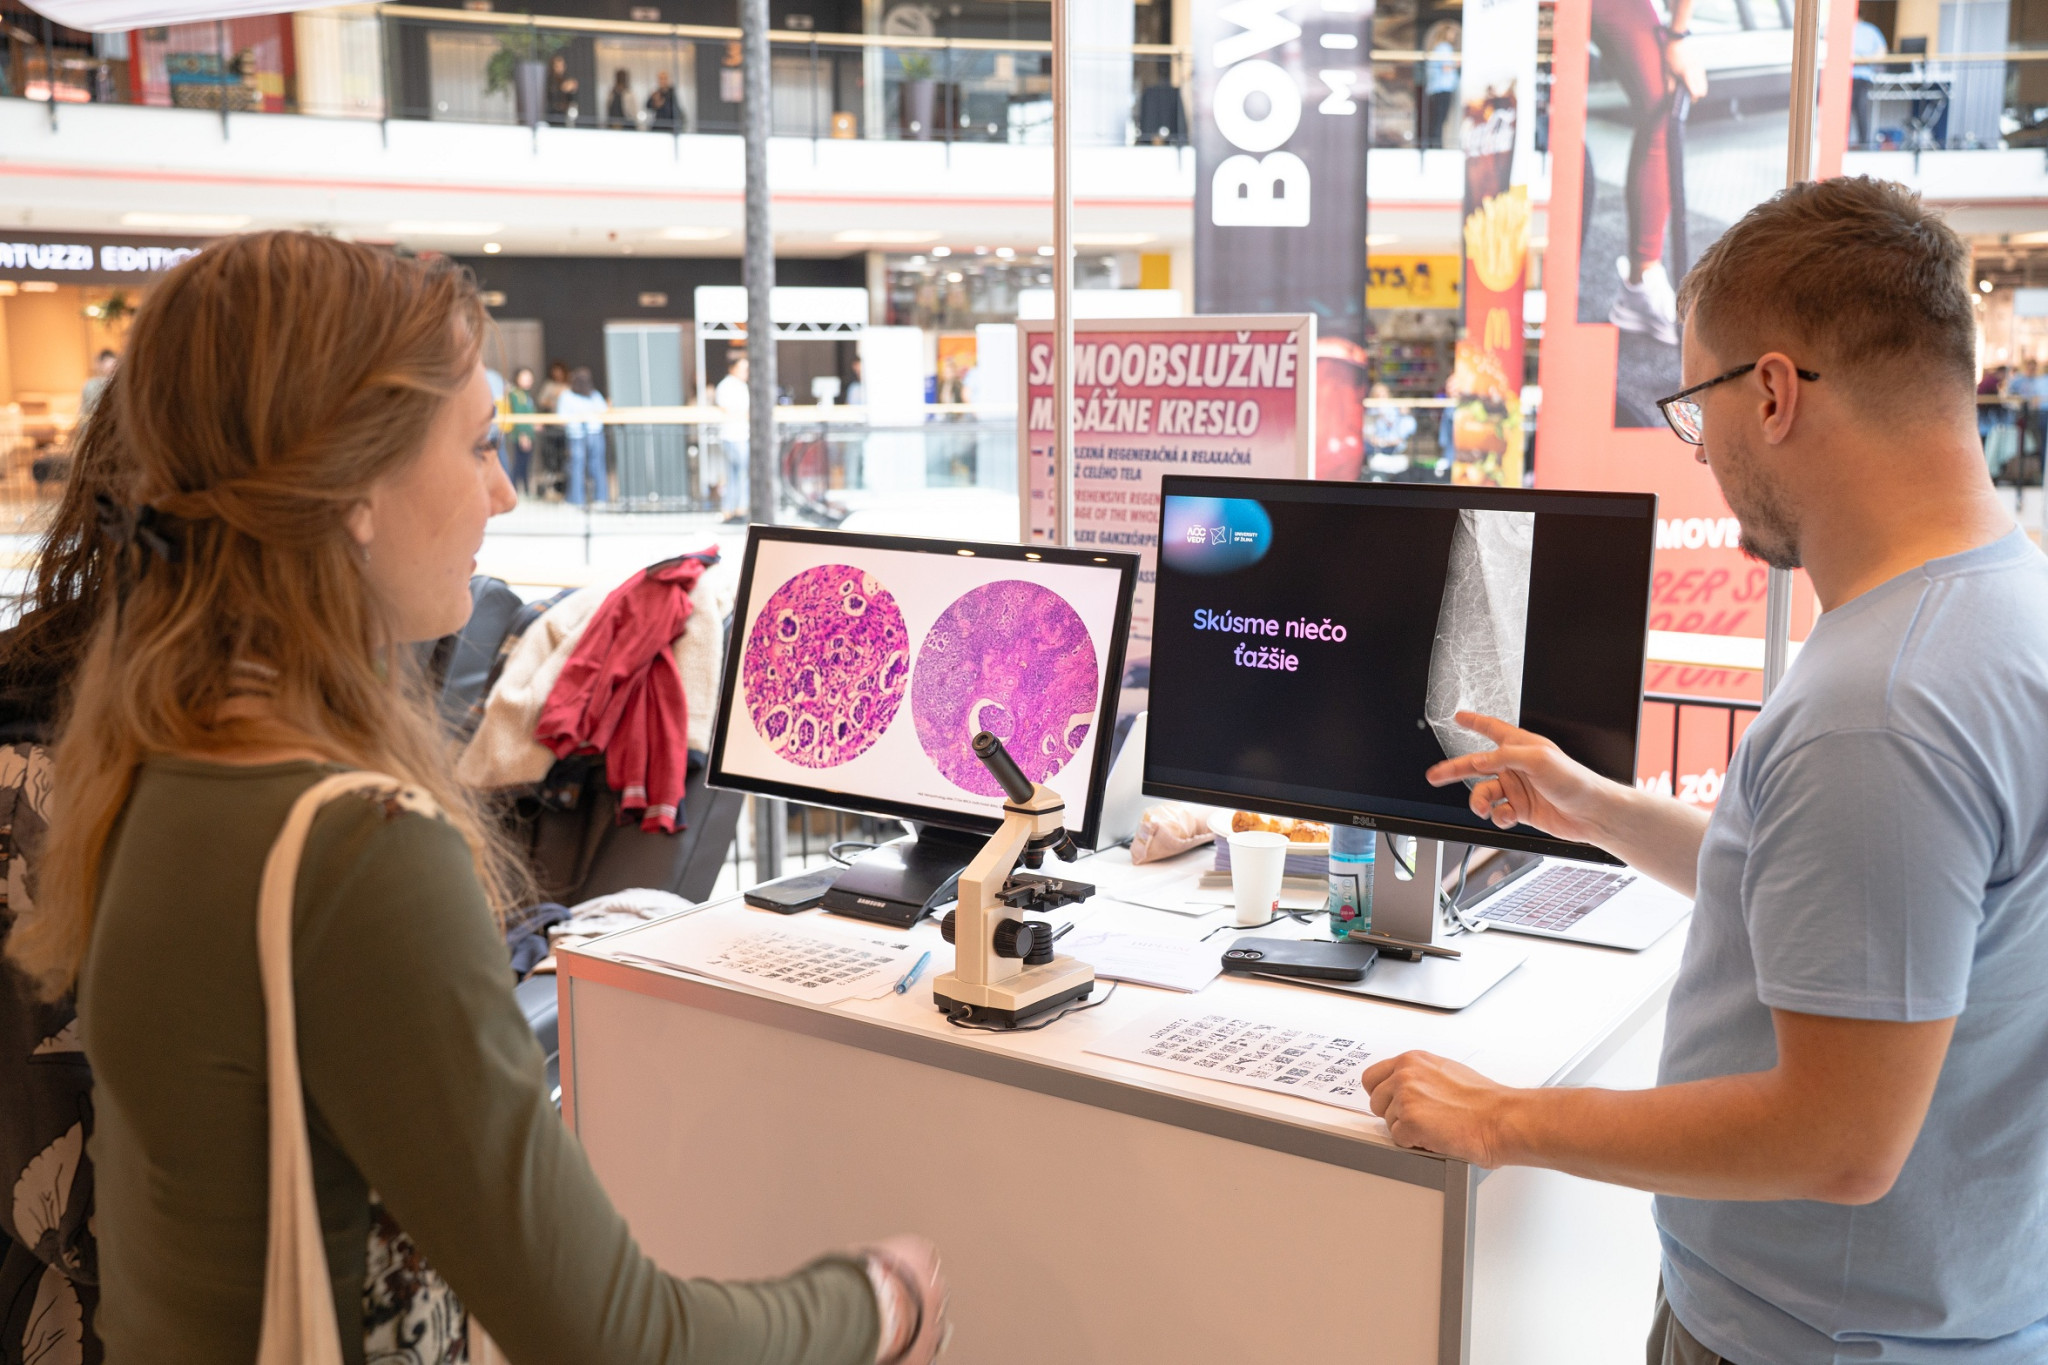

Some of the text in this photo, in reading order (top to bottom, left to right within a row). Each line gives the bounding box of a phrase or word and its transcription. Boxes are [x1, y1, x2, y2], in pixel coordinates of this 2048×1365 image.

[101, 246, 202, 271] EDITIO
[1029, 331, 1297, 387] SMOOBSLUŽNÉ
[1029, 389, 1259, 436] MSÁŽNE KRESLO
[1180, 450, 1188, 463] A
[1191, 448, 1251, 465] RELAXAČNÁ
[1083, 464, 1118, 479] CELÉHO
[1121, 467, 1142, 480] TELA
[1129, 491, 1160, 505] REGEN
[1130, 509, 1159, 523] WHOL
[1099, 530, 1158, 546] GANZKÖRPE
[1187, 536, 1206, 544] VEDY
[1193, 609, 1347, 642] Skúsme niečo
[1234, 643, 1299, 672] ťažšie
[1679, 768, 1725, 803] ZÓ
[1353, 816, 1376, 827] DELL
[857, 898, 886, 908] SAMSUNG
[1150, 1021, 1182, 1039] DATASET
